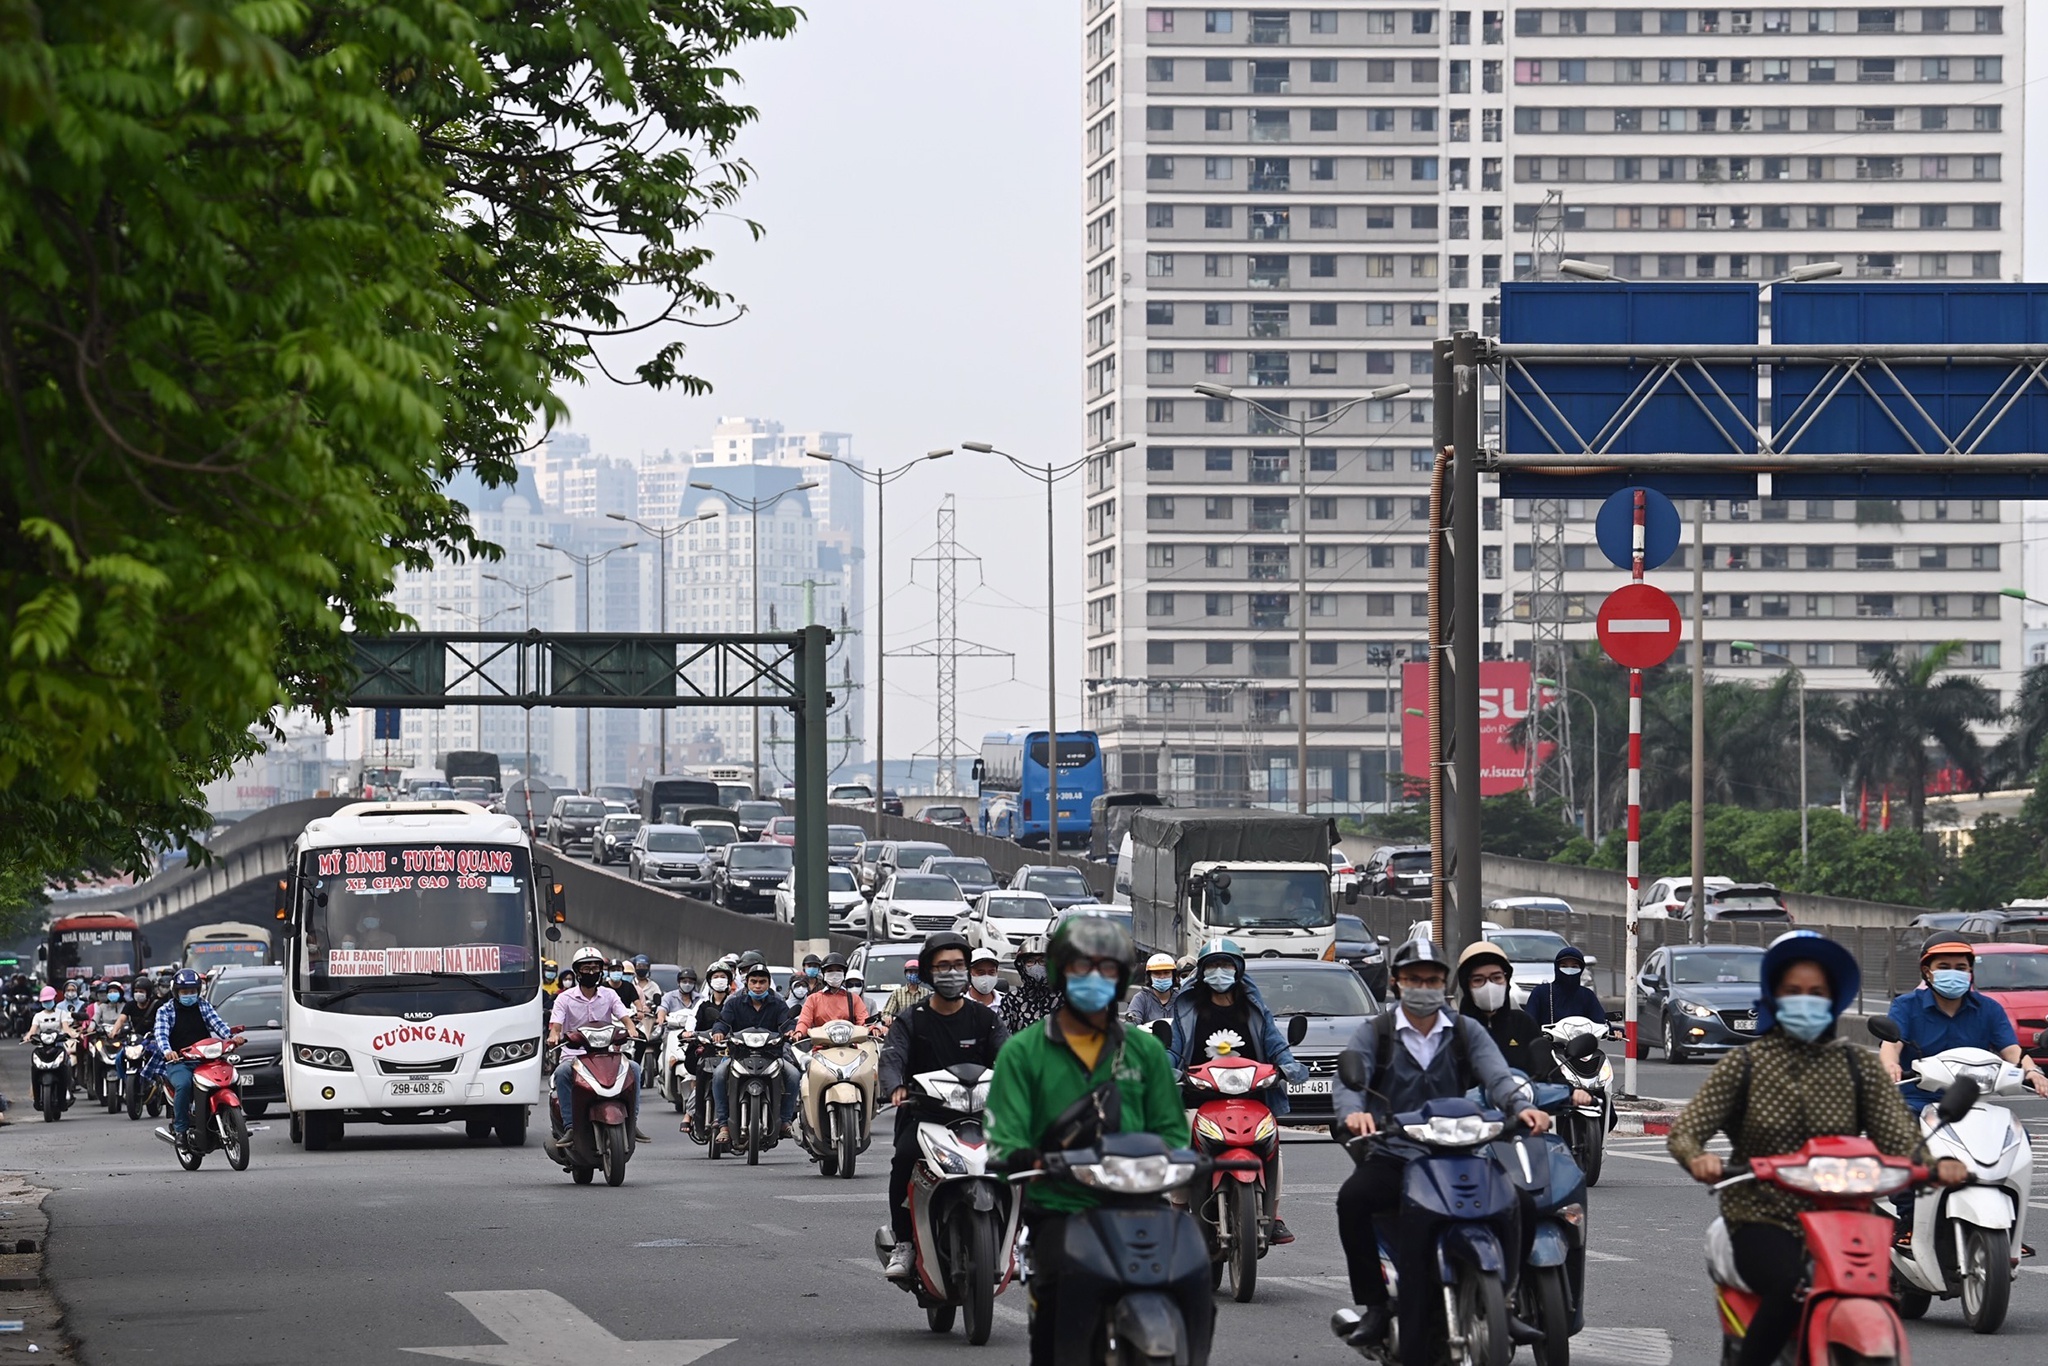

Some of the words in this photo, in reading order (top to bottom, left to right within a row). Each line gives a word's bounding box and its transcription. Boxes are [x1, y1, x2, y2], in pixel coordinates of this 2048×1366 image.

[318, 849, 342, 876] MỸ
[345, 847, 386, 874] ĐÌNH
[402, 845, 455, 872] TUYÊN
[456, 850, 512, 875] QUANG
[346, 878, 367, 891] XE
[372, 876, 413, 892] CHẠY
[417, 876, 449, 889] CAO
[457, 873, 487, 890] TỐC
[445, 948, 461, 972] NA
[466, 947, 499, 972] HANG
[373, 1024, 436, 1051] CƯỜNG
[438, 1028, 465, 1047] AN
[242, 1075, 253, 1086] 79
[392, 1083, 443, 1094] 29B-408.26
[1289, 1081, 1333, 1093] 30F-481.
